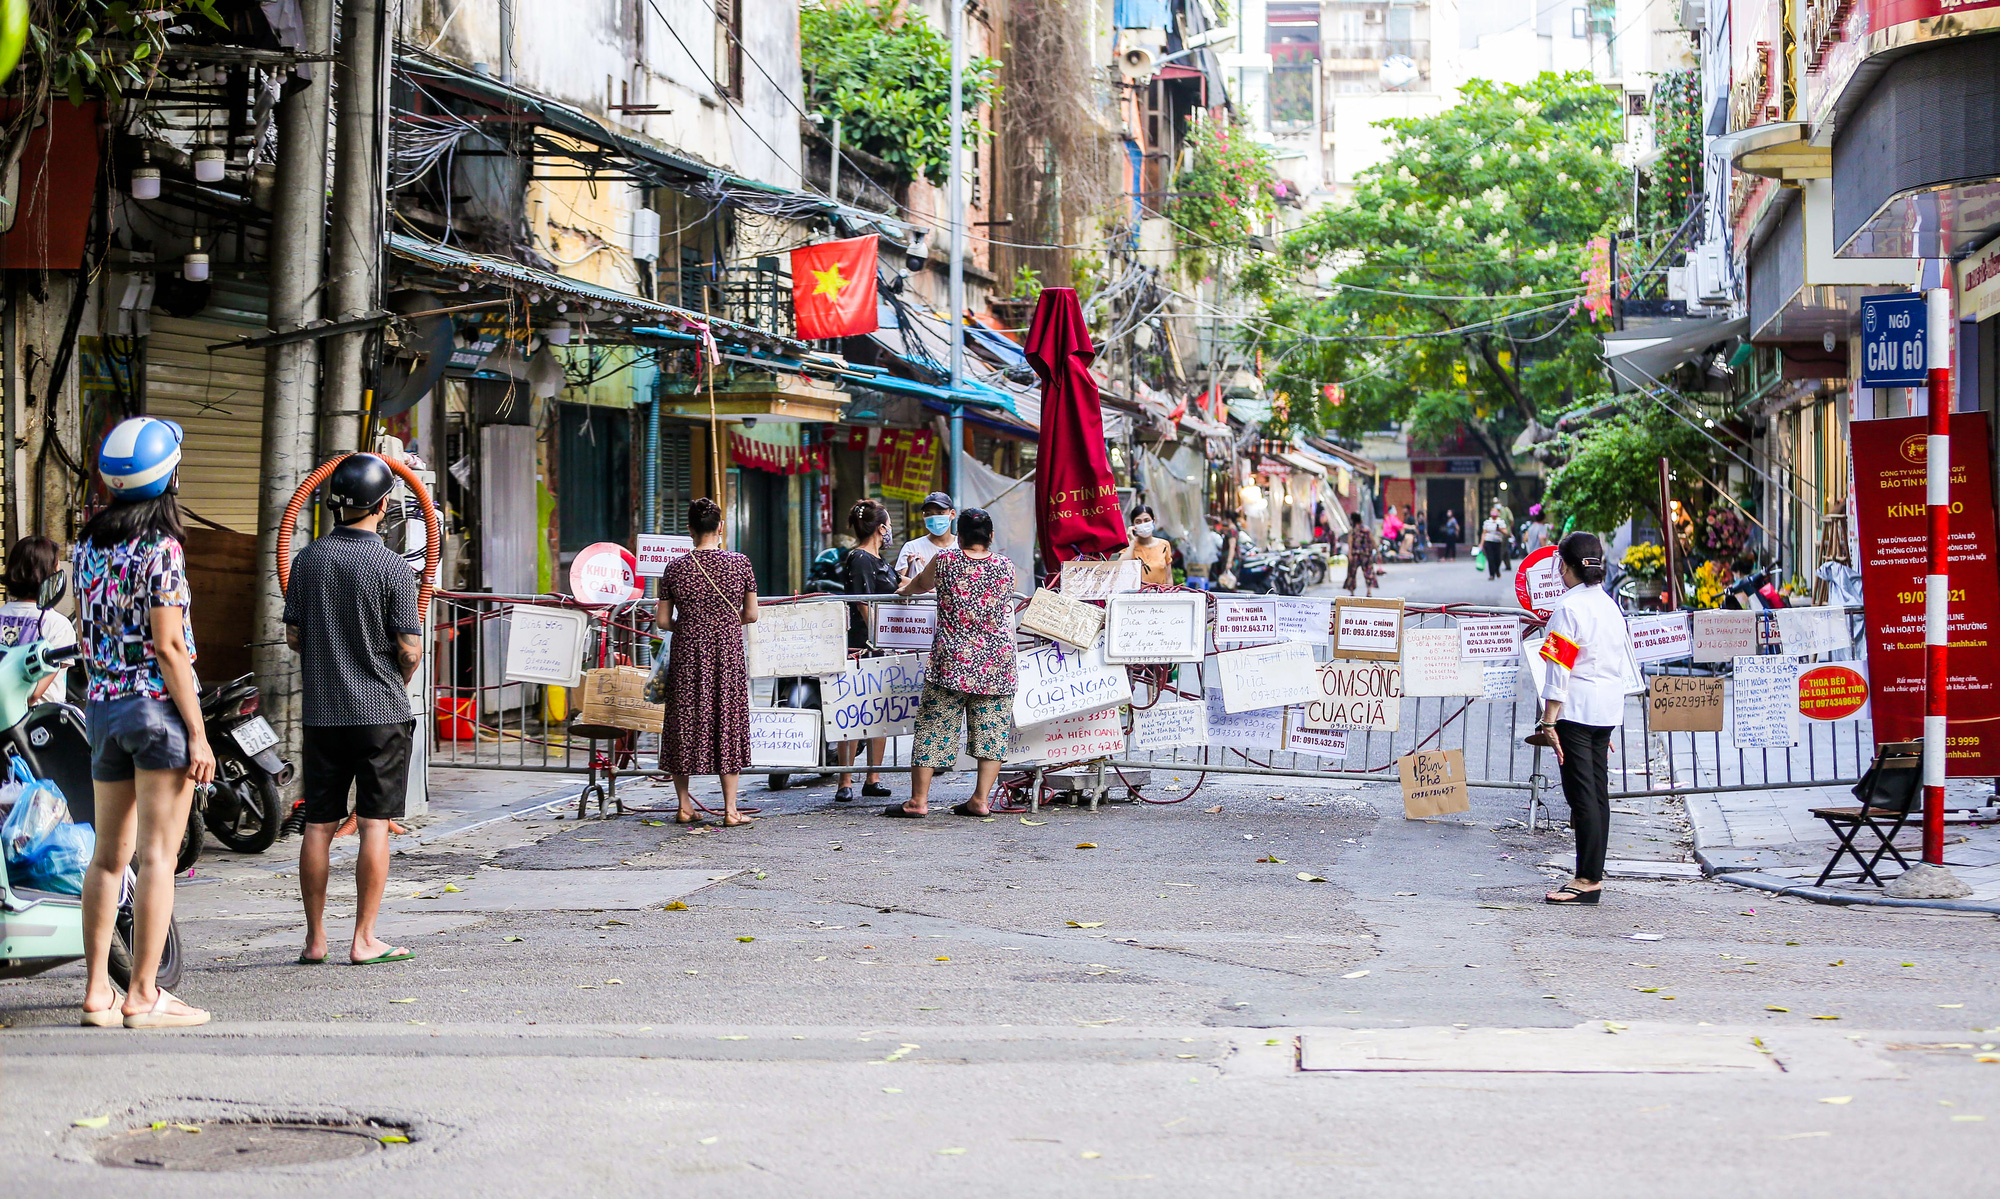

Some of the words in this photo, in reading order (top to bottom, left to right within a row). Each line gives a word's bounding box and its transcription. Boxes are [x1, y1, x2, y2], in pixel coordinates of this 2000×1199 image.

[1888, 310, 1911, 329] NGÕ
[1867, 331, 1899, 372] CẦU
[1902, 328, 1925, 371] GỖ
[1880, 477, 1901, 489] BẢO
[1902, 477, 1918, 487] TÍN
[1069, 485, 1095, 502] TÍN
[1887, 502, 1927, 518] KÍNH
[1870, 558, 1894, 566] COVID-19
[1894, 557, 1909, 565] THEO
[587, 564, 608, 577] KHU
[1537, 609, 1548, 617] NO
[832, 668, 883, 703] BÚN
[1809, 678, 1829, 687] THOA
[1830, 686, 1846, 695] HOA
